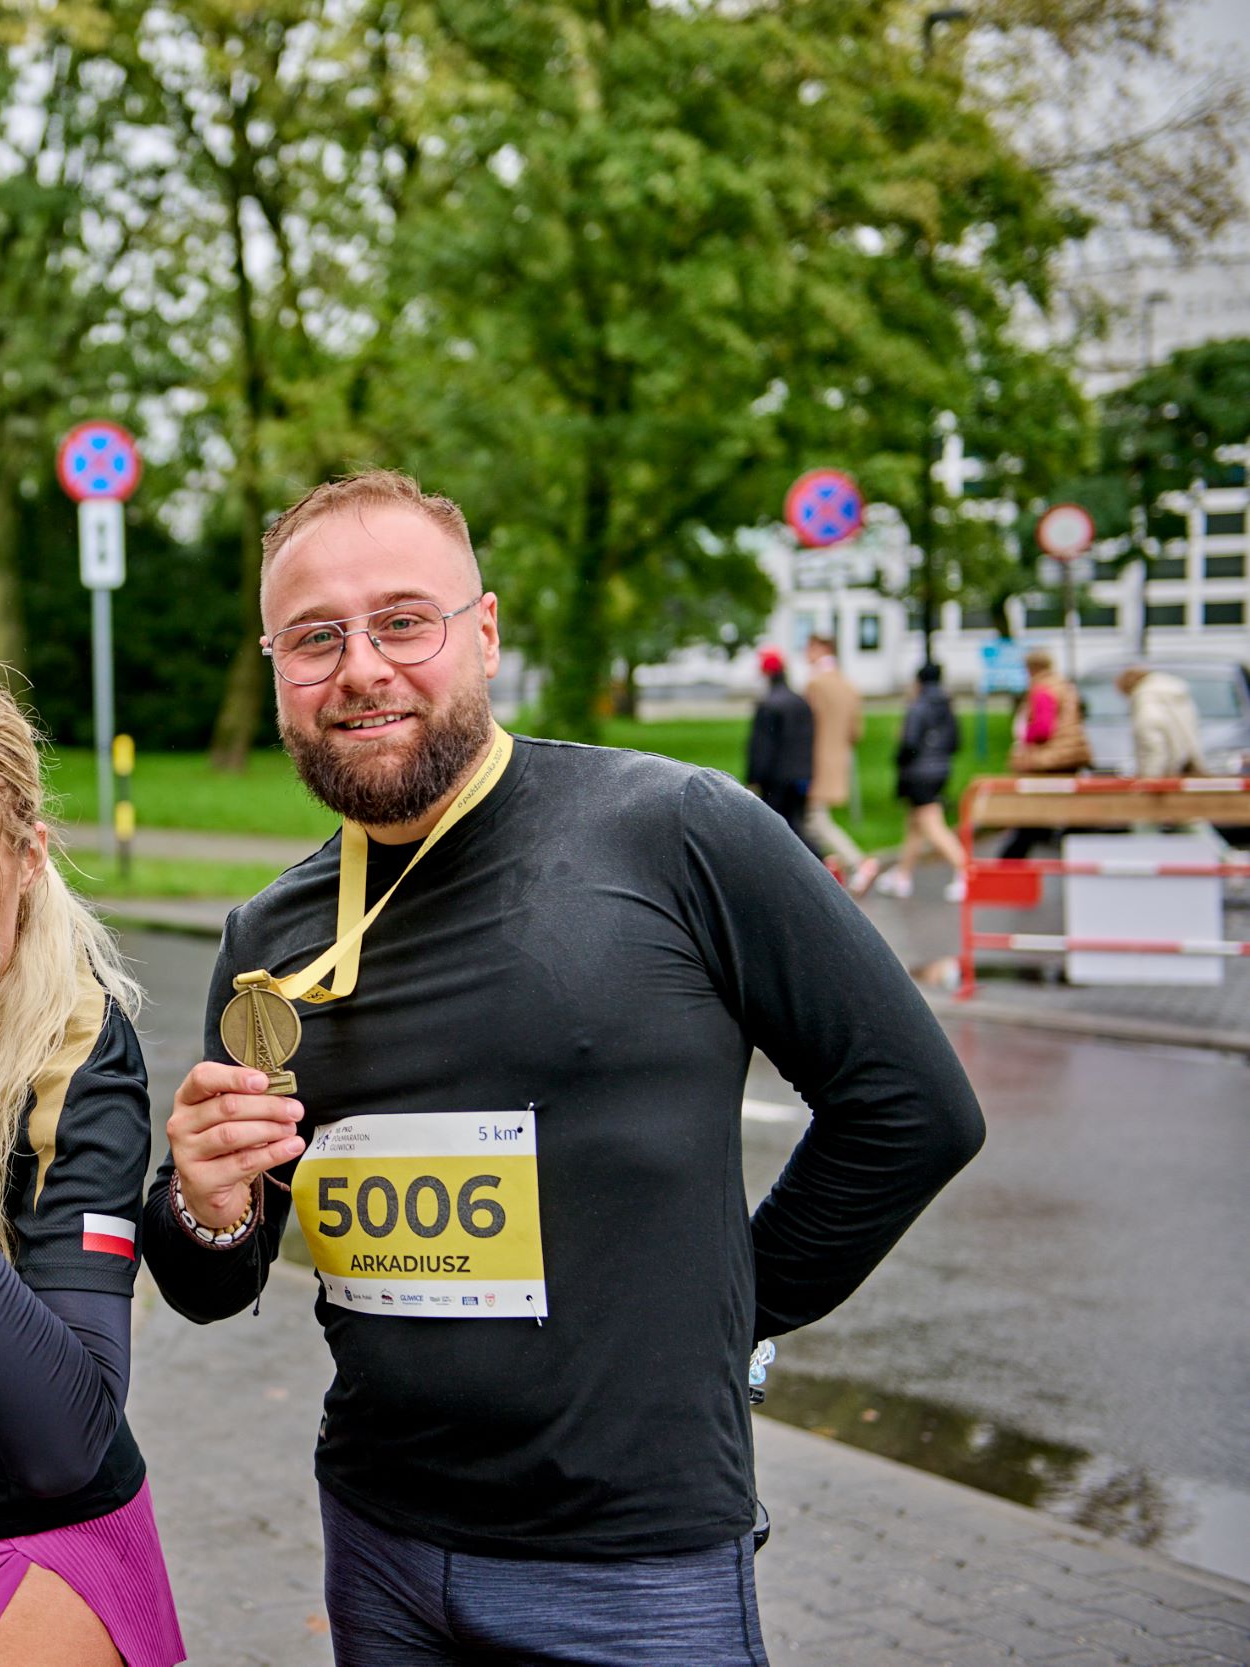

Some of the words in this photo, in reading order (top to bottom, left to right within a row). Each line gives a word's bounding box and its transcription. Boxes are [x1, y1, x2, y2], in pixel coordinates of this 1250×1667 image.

[478, 1126, 488, 1141] 5
[494, 1124, 518, 1141] km
[318, 1174, 506, 1239] 5006
[350, 1254, 471, 1274] ARKADIUSZ
